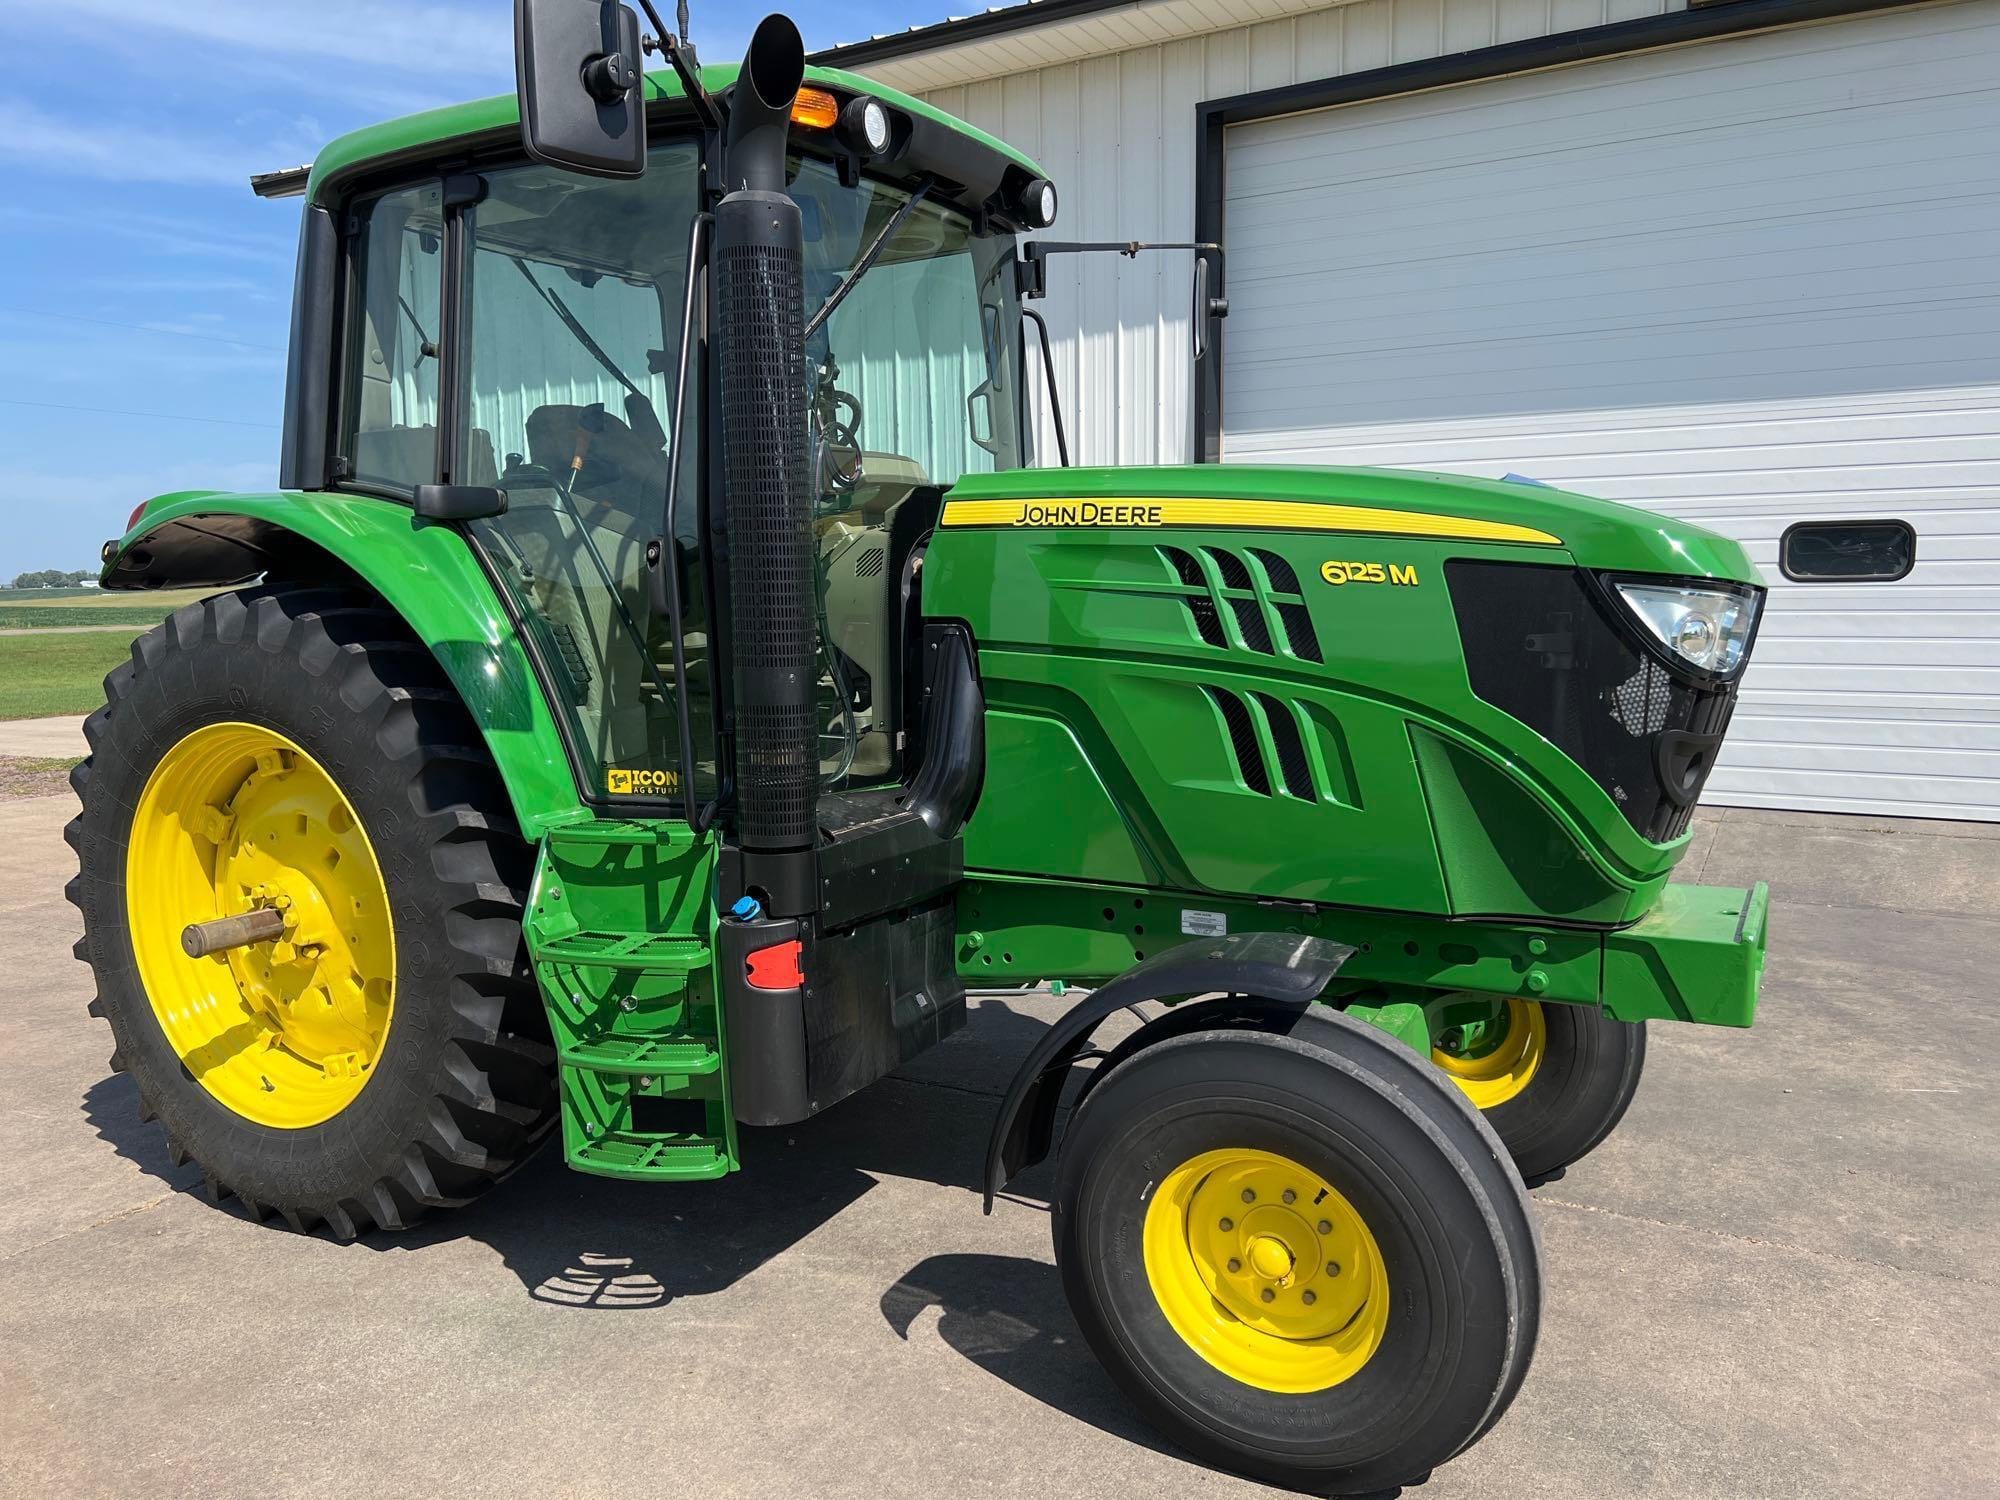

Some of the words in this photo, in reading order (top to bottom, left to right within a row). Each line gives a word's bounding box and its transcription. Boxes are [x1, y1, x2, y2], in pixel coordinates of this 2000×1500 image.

[1016, 502, 1076, 523] JOHN
[1081, 502, 1162, 523] DEERE
[632, 770, 678, 786] ICON
[633, 786, 646, 794] AG
[655, 787, 679, 795] TURF
